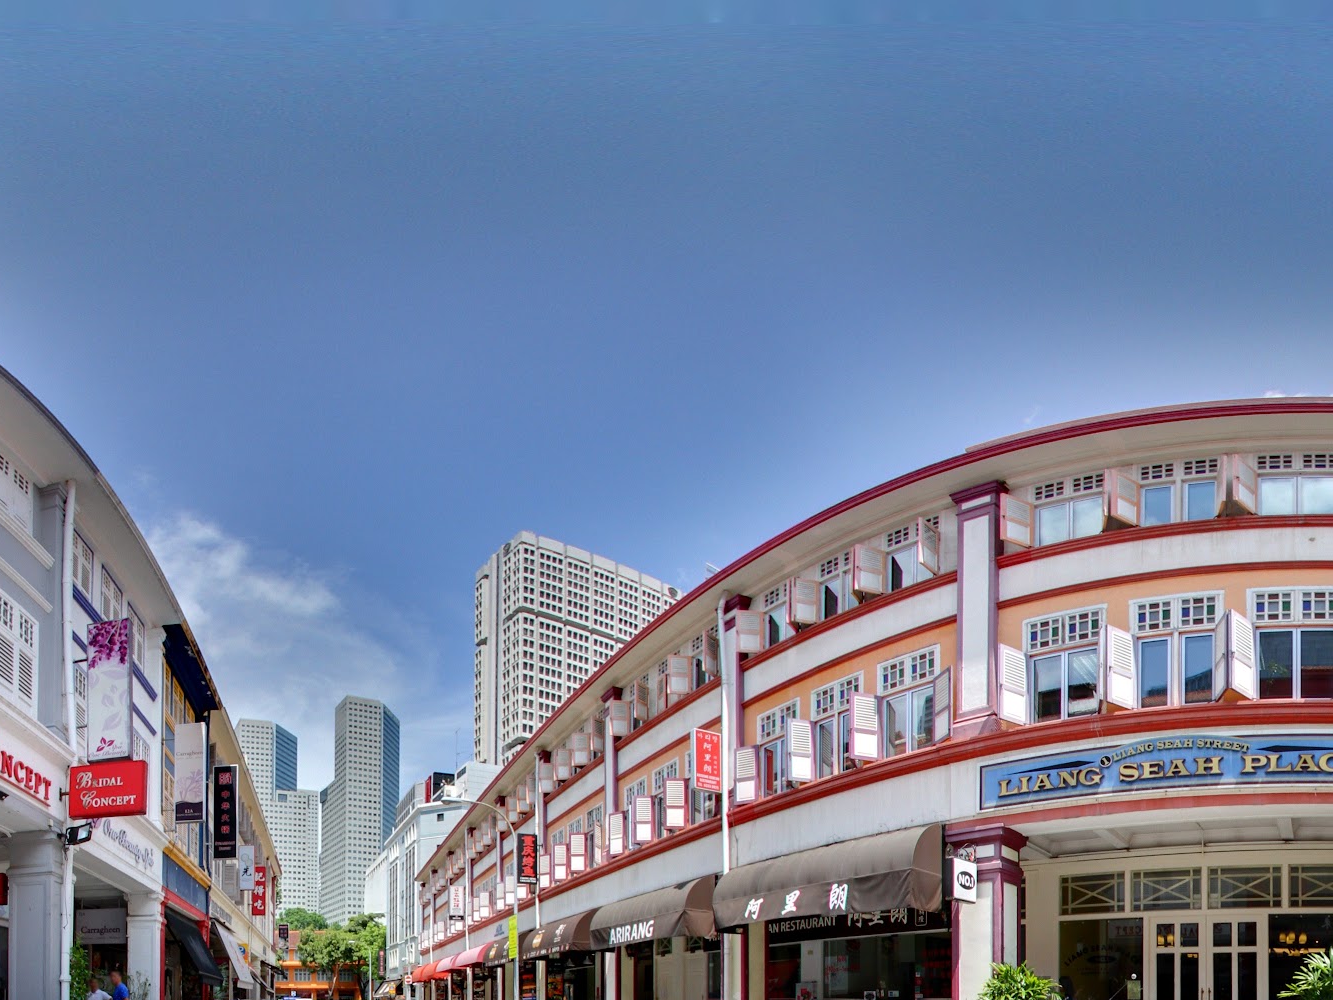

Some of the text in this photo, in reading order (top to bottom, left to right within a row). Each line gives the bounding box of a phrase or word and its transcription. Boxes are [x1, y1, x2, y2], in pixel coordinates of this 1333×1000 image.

[1111, 742, 1154, 762] LIANG
[1156, 738, 1194, 750] SEAH
[1196, 738, 1251, 753] STREET
[75, 771, 124, 789] BRIDAL
[998, 767, 1104, 797] LIANG
[1118, 756, 1224, 782] SEAH
[80, 790, 136, 809] CONCEPT
[521, 835, 536, 877] 重庆烤鱼
[958, 874, 975, 888] NO.1
[744, 883, 849, 920] 阿里朗
[80, 925, 121, 936] Carragheen
[608, 919, 655, 945] ARIRANG
[780, 915, 837, 933] RESTAURANT
